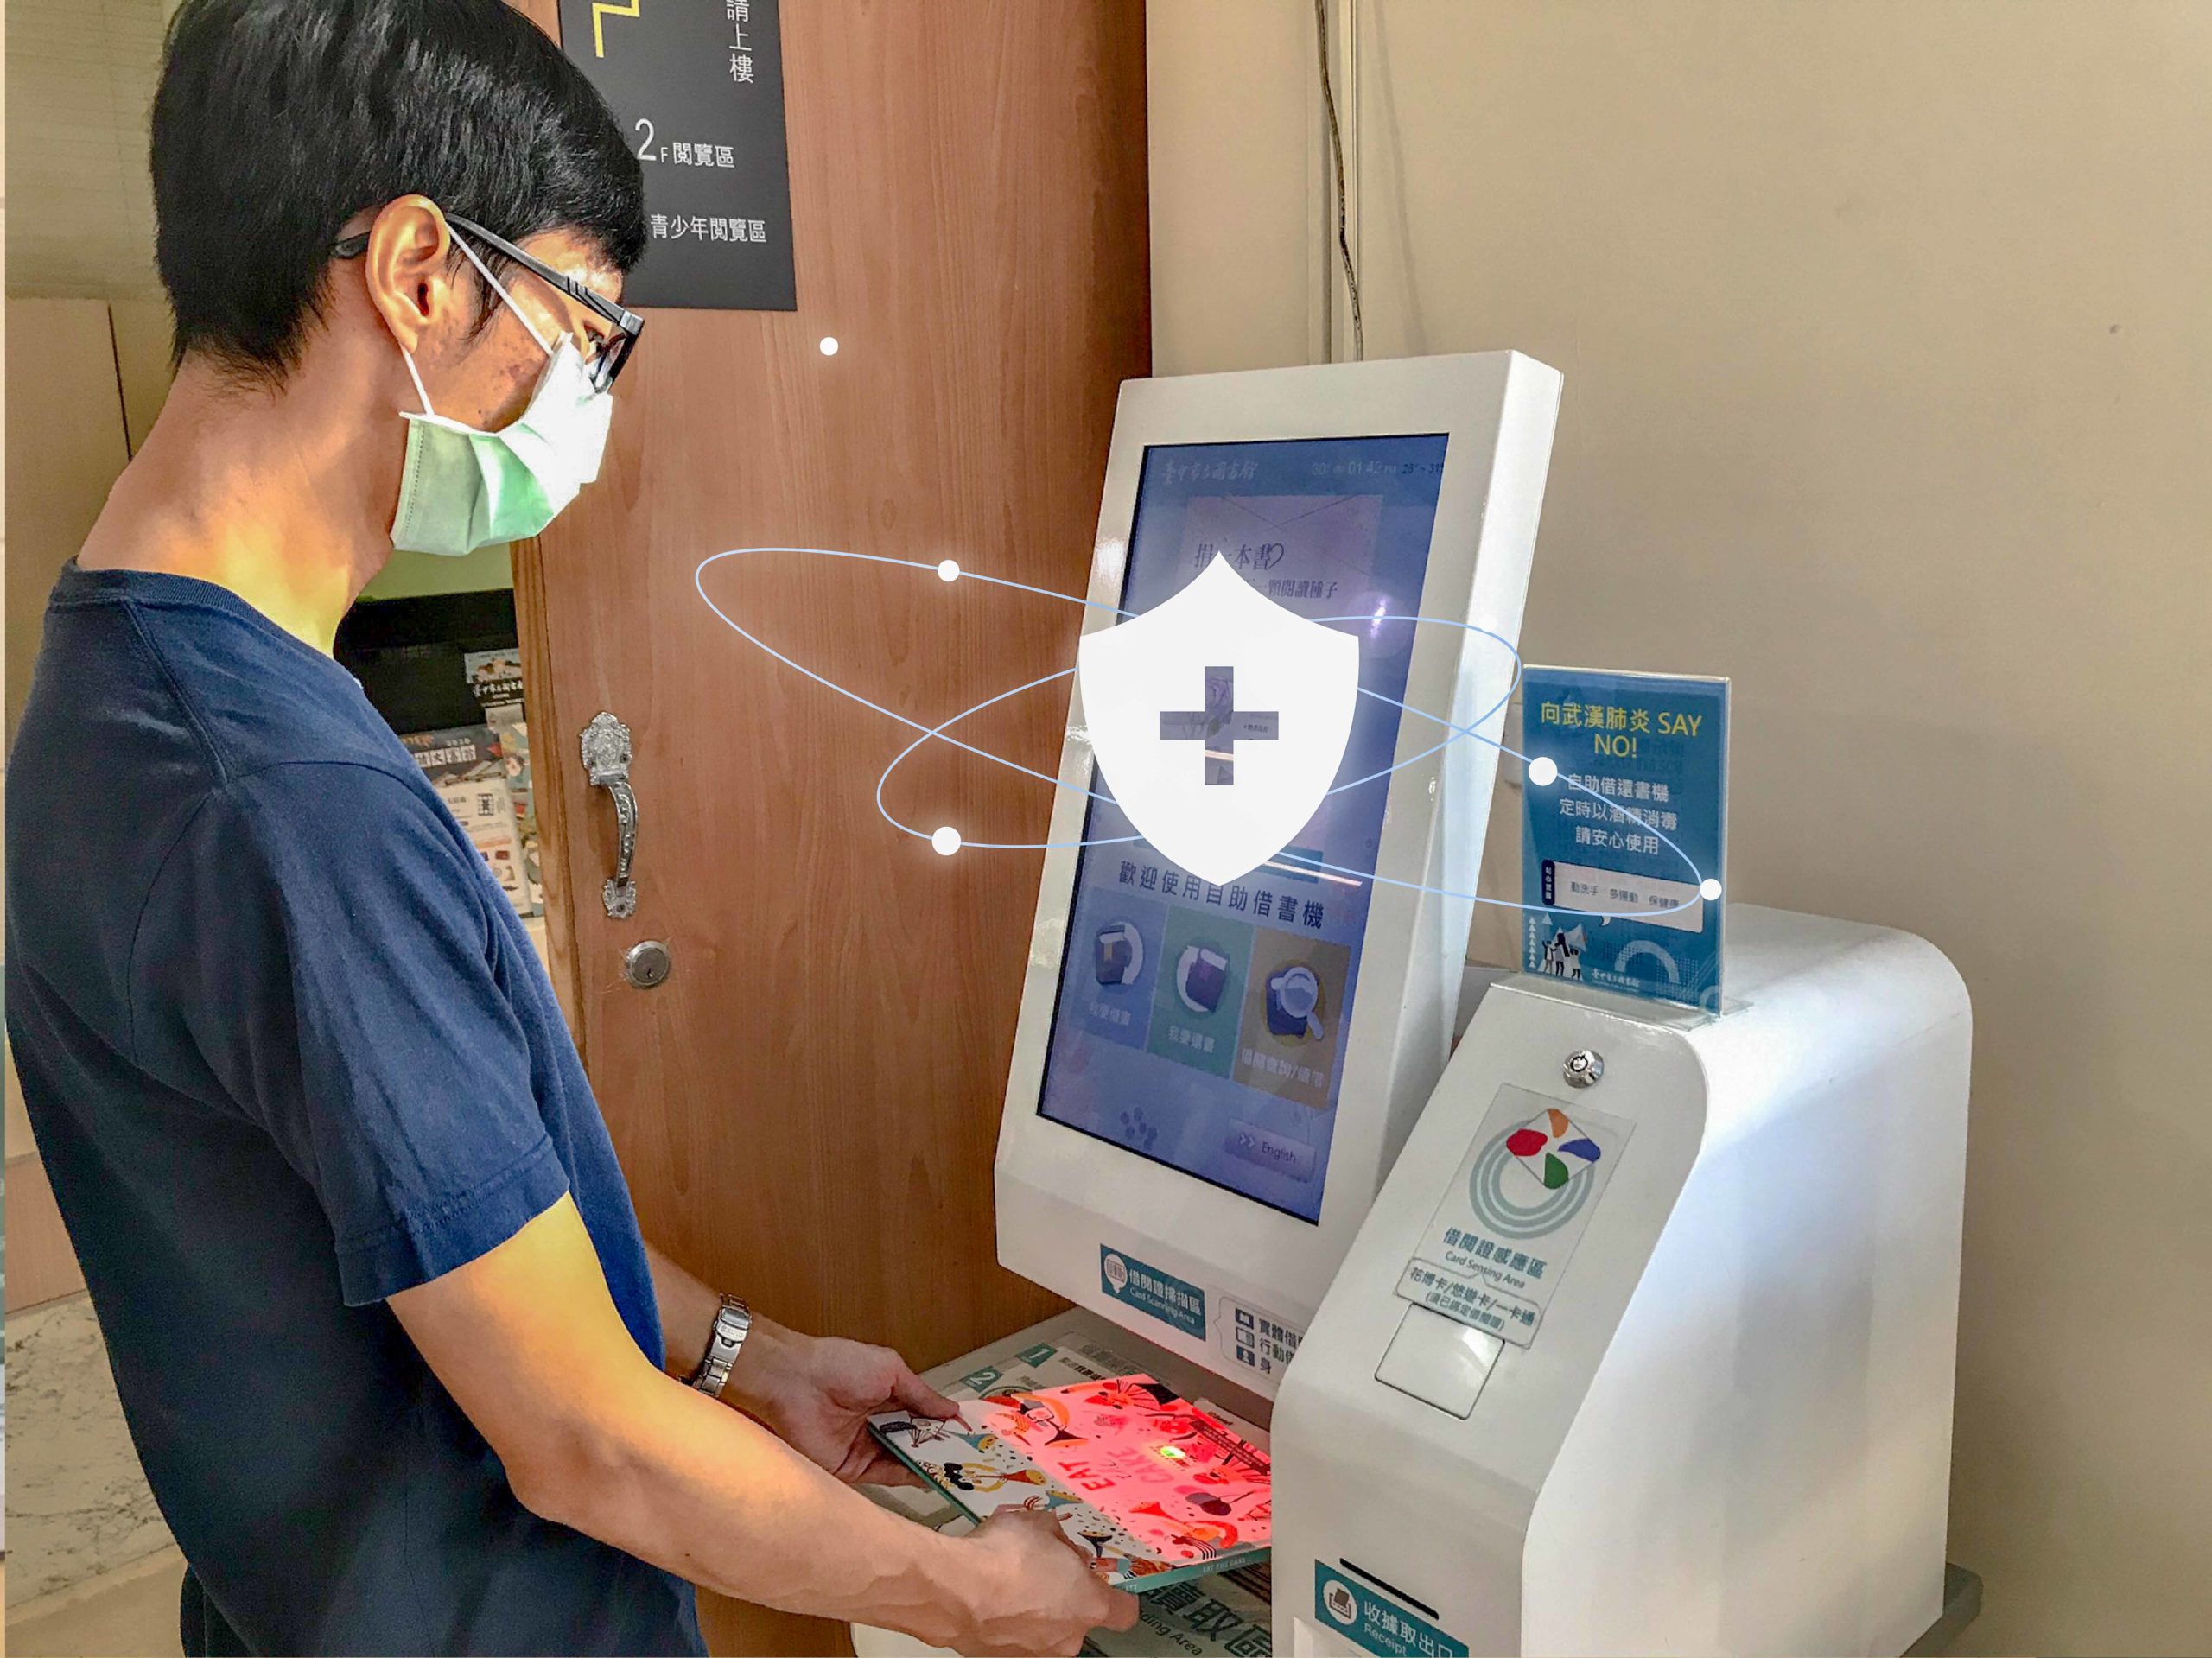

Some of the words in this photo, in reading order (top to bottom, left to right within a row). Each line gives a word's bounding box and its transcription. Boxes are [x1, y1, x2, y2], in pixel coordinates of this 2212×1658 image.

[726, 0, 754, 83] 請上樓
[650, 213, 767, 243] 青少年閱覽區
[1194, 543, 1272, 570] 捐本書
[1541, 702, 1650, 734] 向武漢肺炎
[1657, 712, 1702, 737] SAY
[1594, 734, 1637, 758] NO!
[1567, 773, 1669, 803] 自助借還書機
[1559, 797, 1677, 831] 定時以酒精消毒
[1575, 825, 1659, 855] 請安心使用
[1118, 860, 1325, 930] 歡迎使用自助借書機
[1262, 1141, 1296, 1164] English
[1443, 1227, 1548, 1279] 借閱證感應區
[1445, 1250, 1466, 1266] Card
[1468, 1259, 1503, 1282] Sensing
[1503, 1274, 1525, 1289] Area
[1129, 1286, 1147, 1301] Card
[1179, 1312, 1195, 1324] Area
[1057, 1461, 1116, 1491] EAT
[1140, 1611, 1171, 1636] ding
[1170, 1631, 1203, 1656] Area
[1363, 1622, 1408, 1657] Receipt
